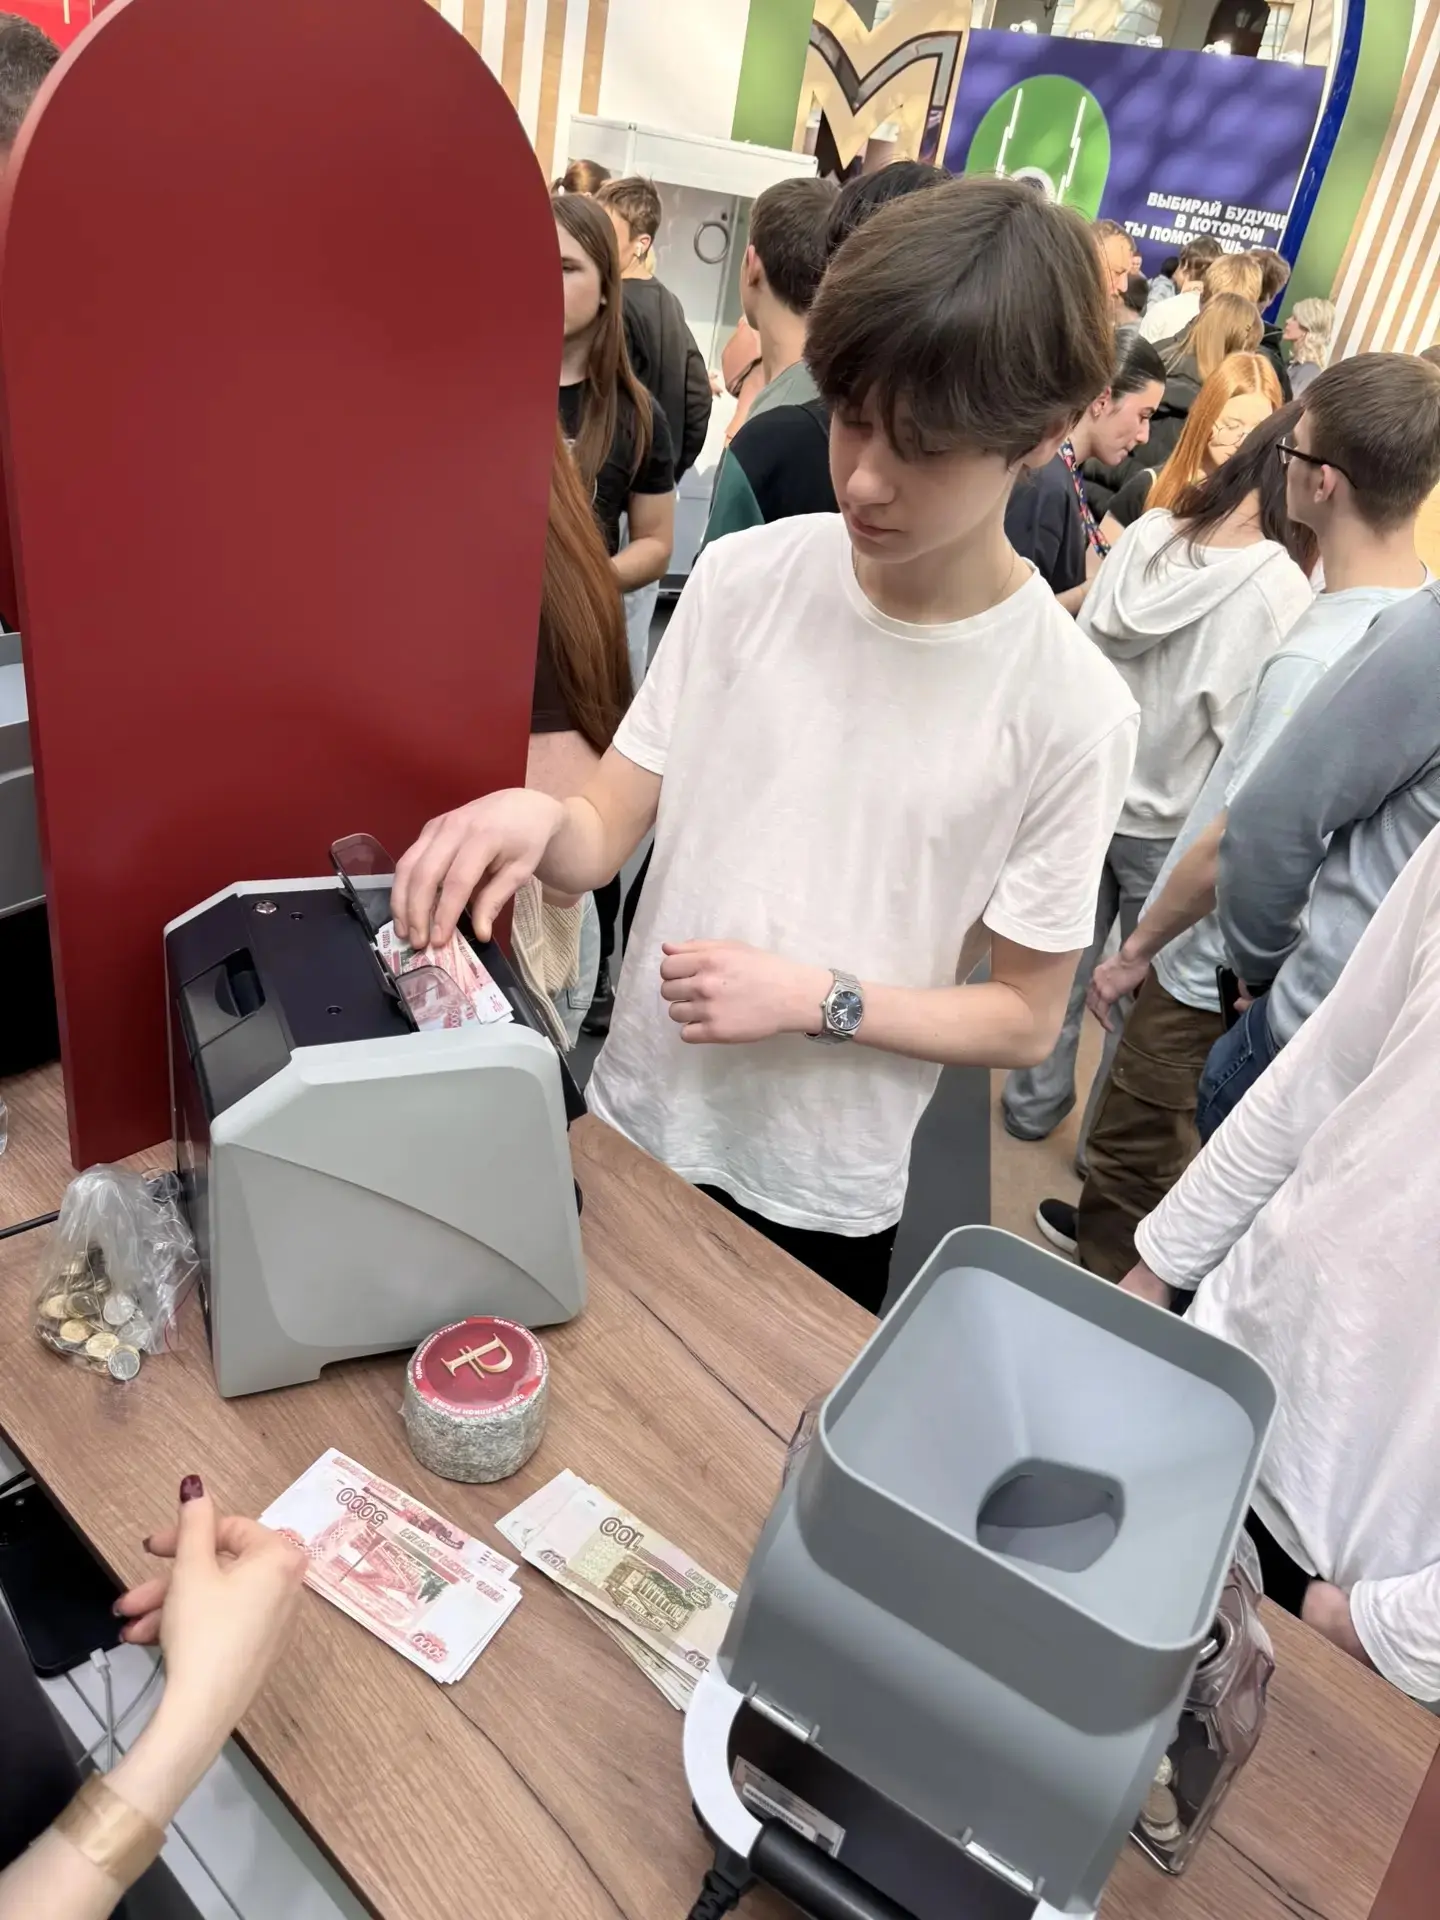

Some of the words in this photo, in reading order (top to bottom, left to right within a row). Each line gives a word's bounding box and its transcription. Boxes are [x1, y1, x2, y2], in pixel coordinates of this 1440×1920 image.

[1147, 192, 1222, 218] ВЫБИРАЙ
[1124, 221, 1147, 238] ТЫ
[1174, 213, 1187, 229] В
[1189, 216, 1265, 243] КОТОРОМ
[336, 1487, 389, 1530] 5000
[599, 1517, 645, 1552] 100
[540, 1549, 568, 1573] 100
[411, 1633, 447, 1663] 5000
[685, 1650, 709, 1672] 00
